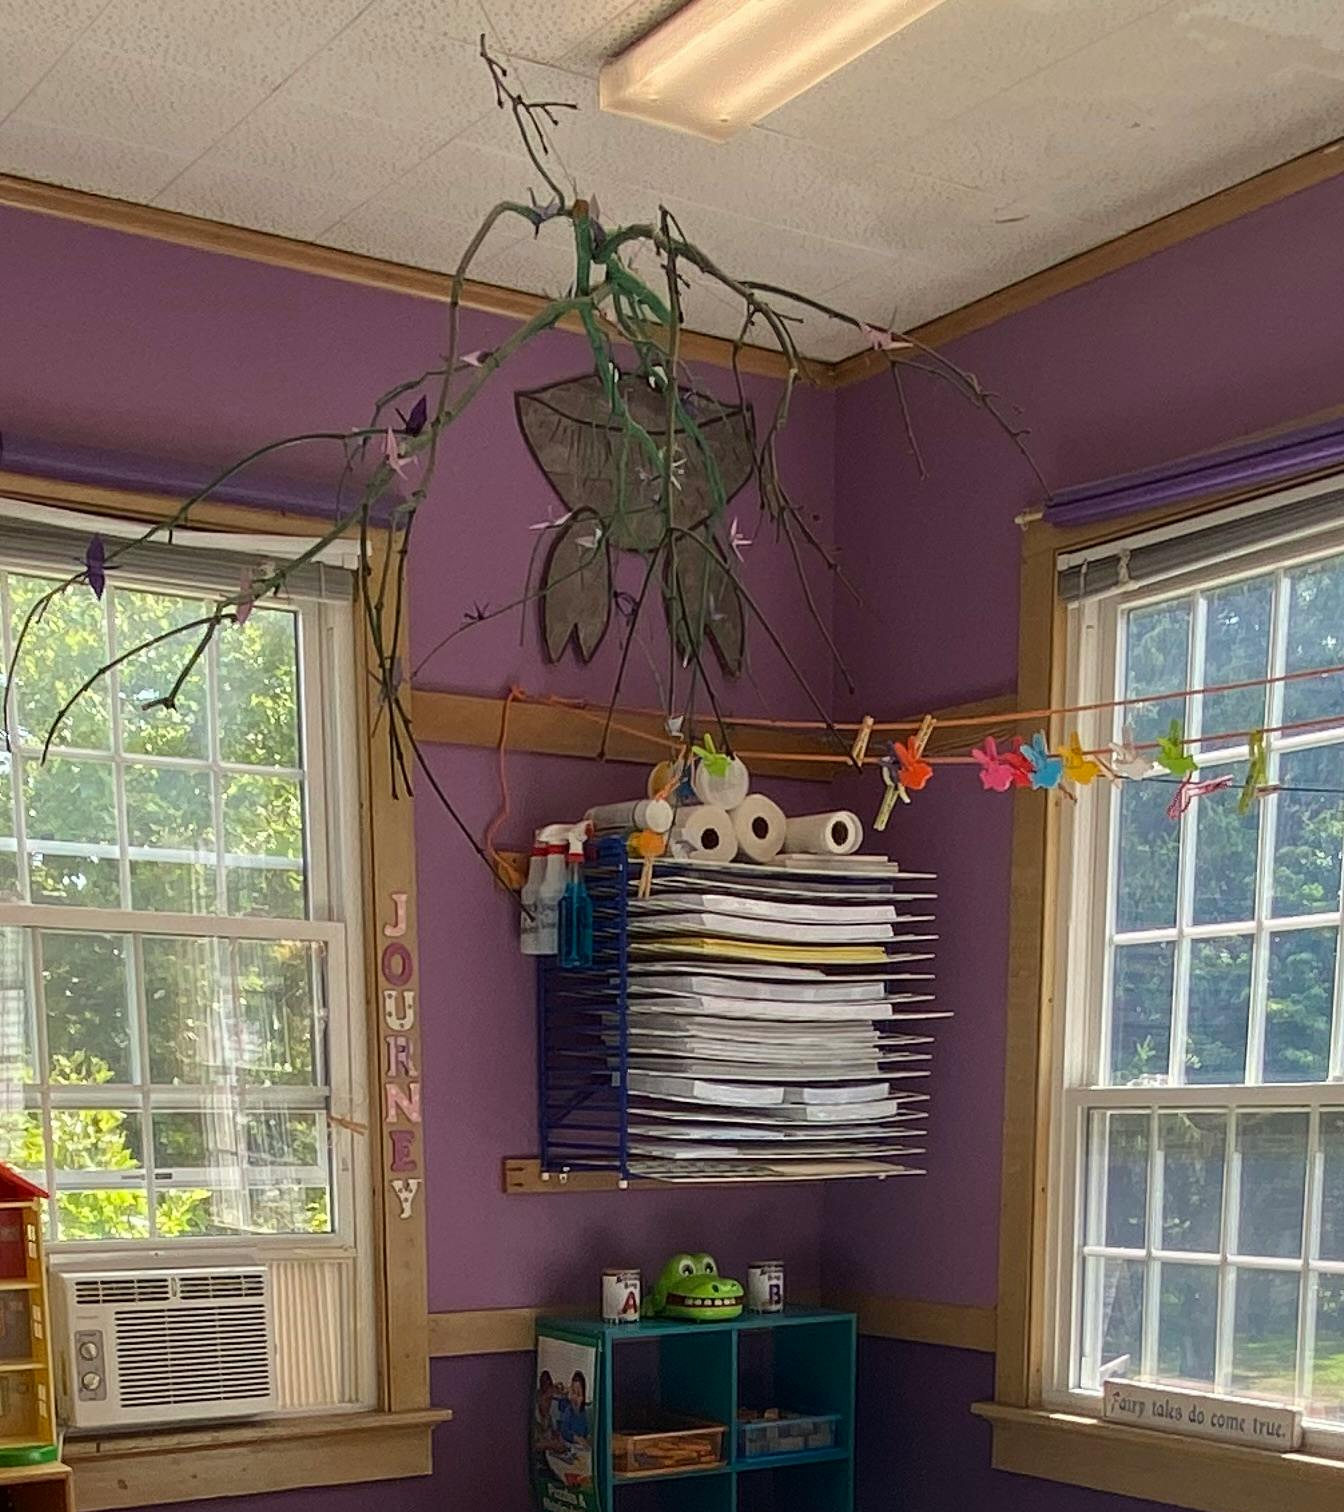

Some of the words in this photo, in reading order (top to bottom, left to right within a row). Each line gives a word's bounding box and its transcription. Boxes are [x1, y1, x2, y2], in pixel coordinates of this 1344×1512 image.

[381, 893, 424, 1220] JOURNEY
[621, 1290, 638, 1315] A
[768, 1283, 782, 1305] B
[1111, 1391, 1146, 1418] Fairy
[1152, 1399, 1183, 1422] tales
[1188, 1403, 1205, 1425] do
[1211, 1412, 1246, 1433] come
[1253, 1417, 1286, 1438] true.
